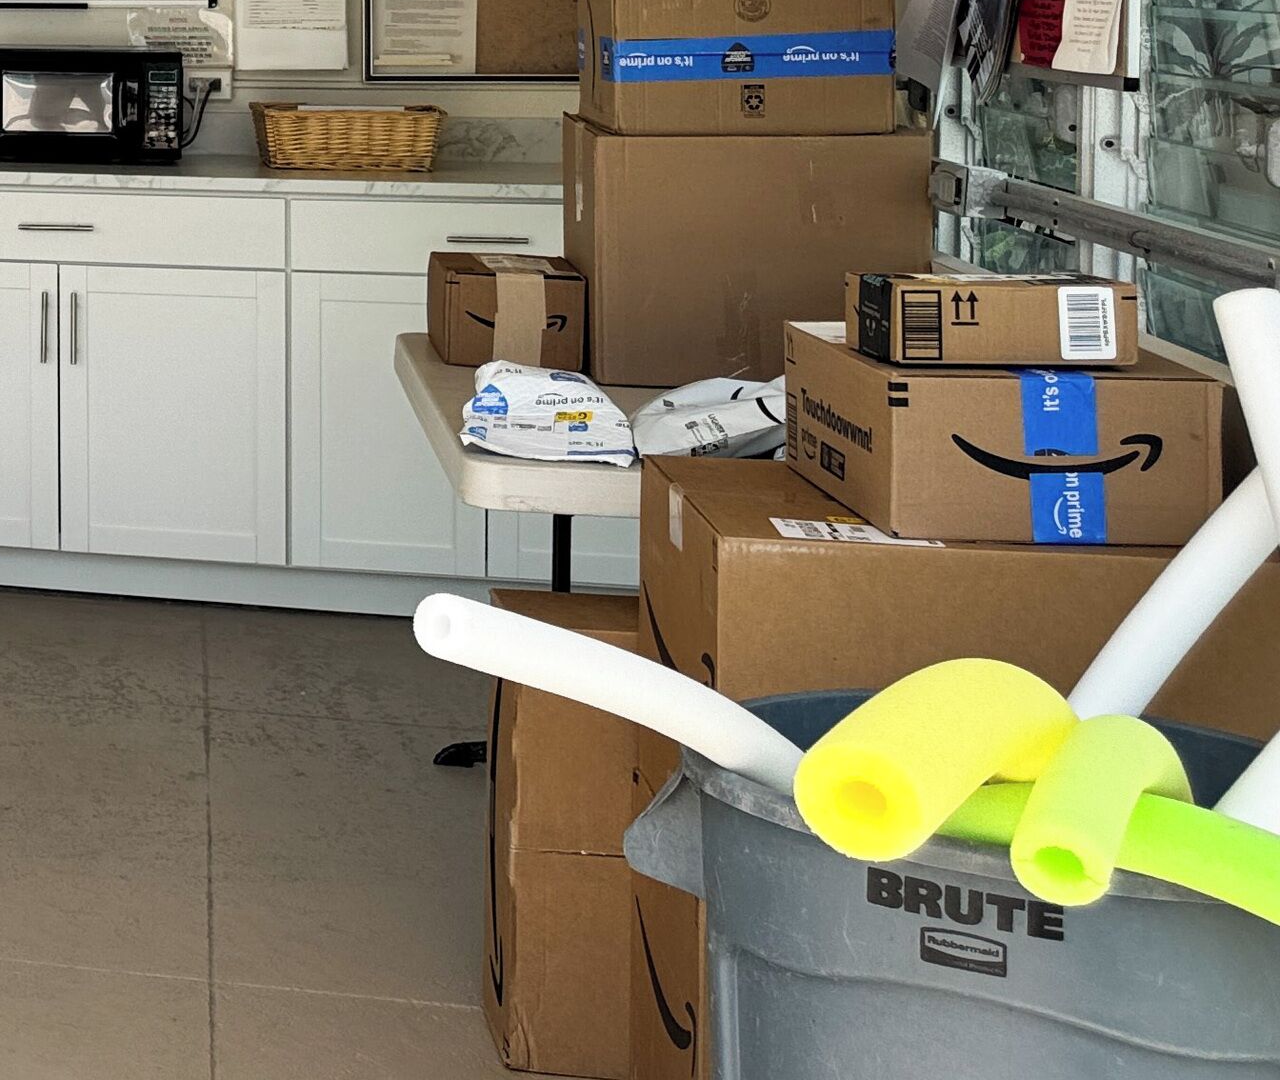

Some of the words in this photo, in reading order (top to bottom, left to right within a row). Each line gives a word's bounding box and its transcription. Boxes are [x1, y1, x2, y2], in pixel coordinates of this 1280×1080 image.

[619, 54, 655, 68] prime
[657, 57, 673, 66] on
[675, 56, 693, 67] It's
[535, 397, 568, 408] prime
[569, 398, 584, 406] on
[587, 397, 604, 405] It's
[1042, 387, 1059, 412] It's
[1063, 491, 1085, 538] prime
[867, 866, 1064, 941] BRUTE
[927, 934, 999, 958] Rubbermaid
